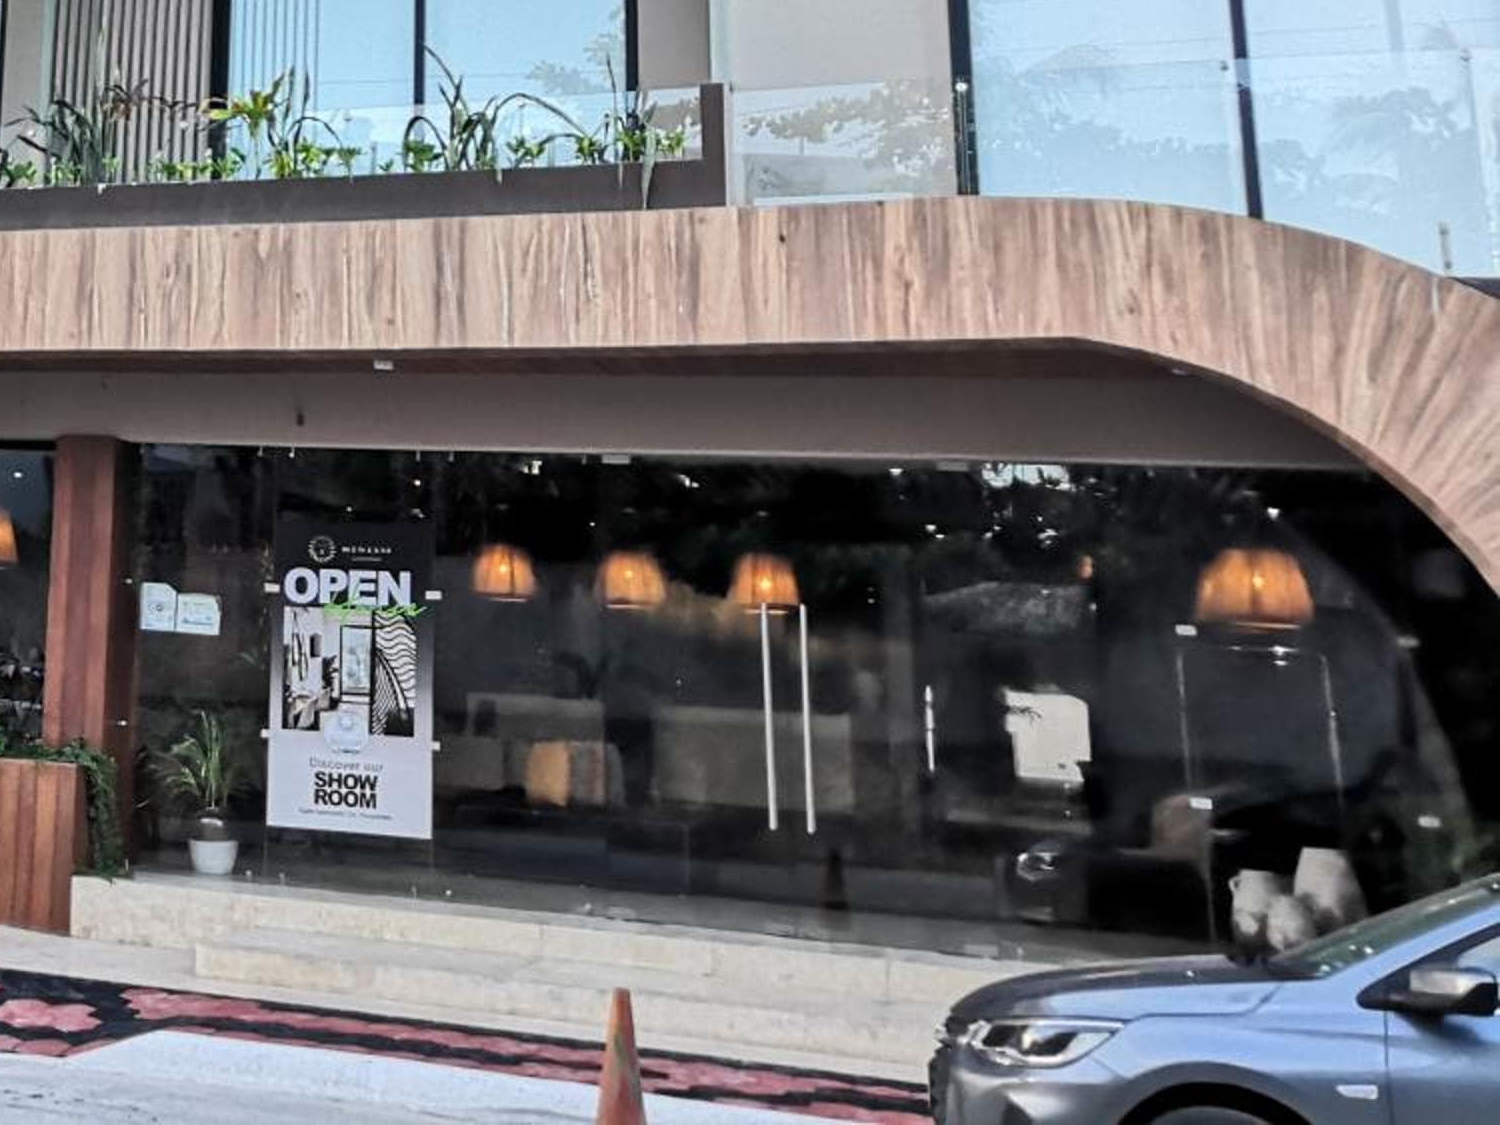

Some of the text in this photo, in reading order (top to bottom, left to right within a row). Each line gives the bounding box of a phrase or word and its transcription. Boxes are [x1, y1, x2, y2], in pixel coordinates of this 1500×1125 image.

[284, 567, 411, 606] OPEN
[309, 756, 360, 771] Discover
[315, 771, 378, 791] SHOW
[314, 789, 377, 809] ROOM
